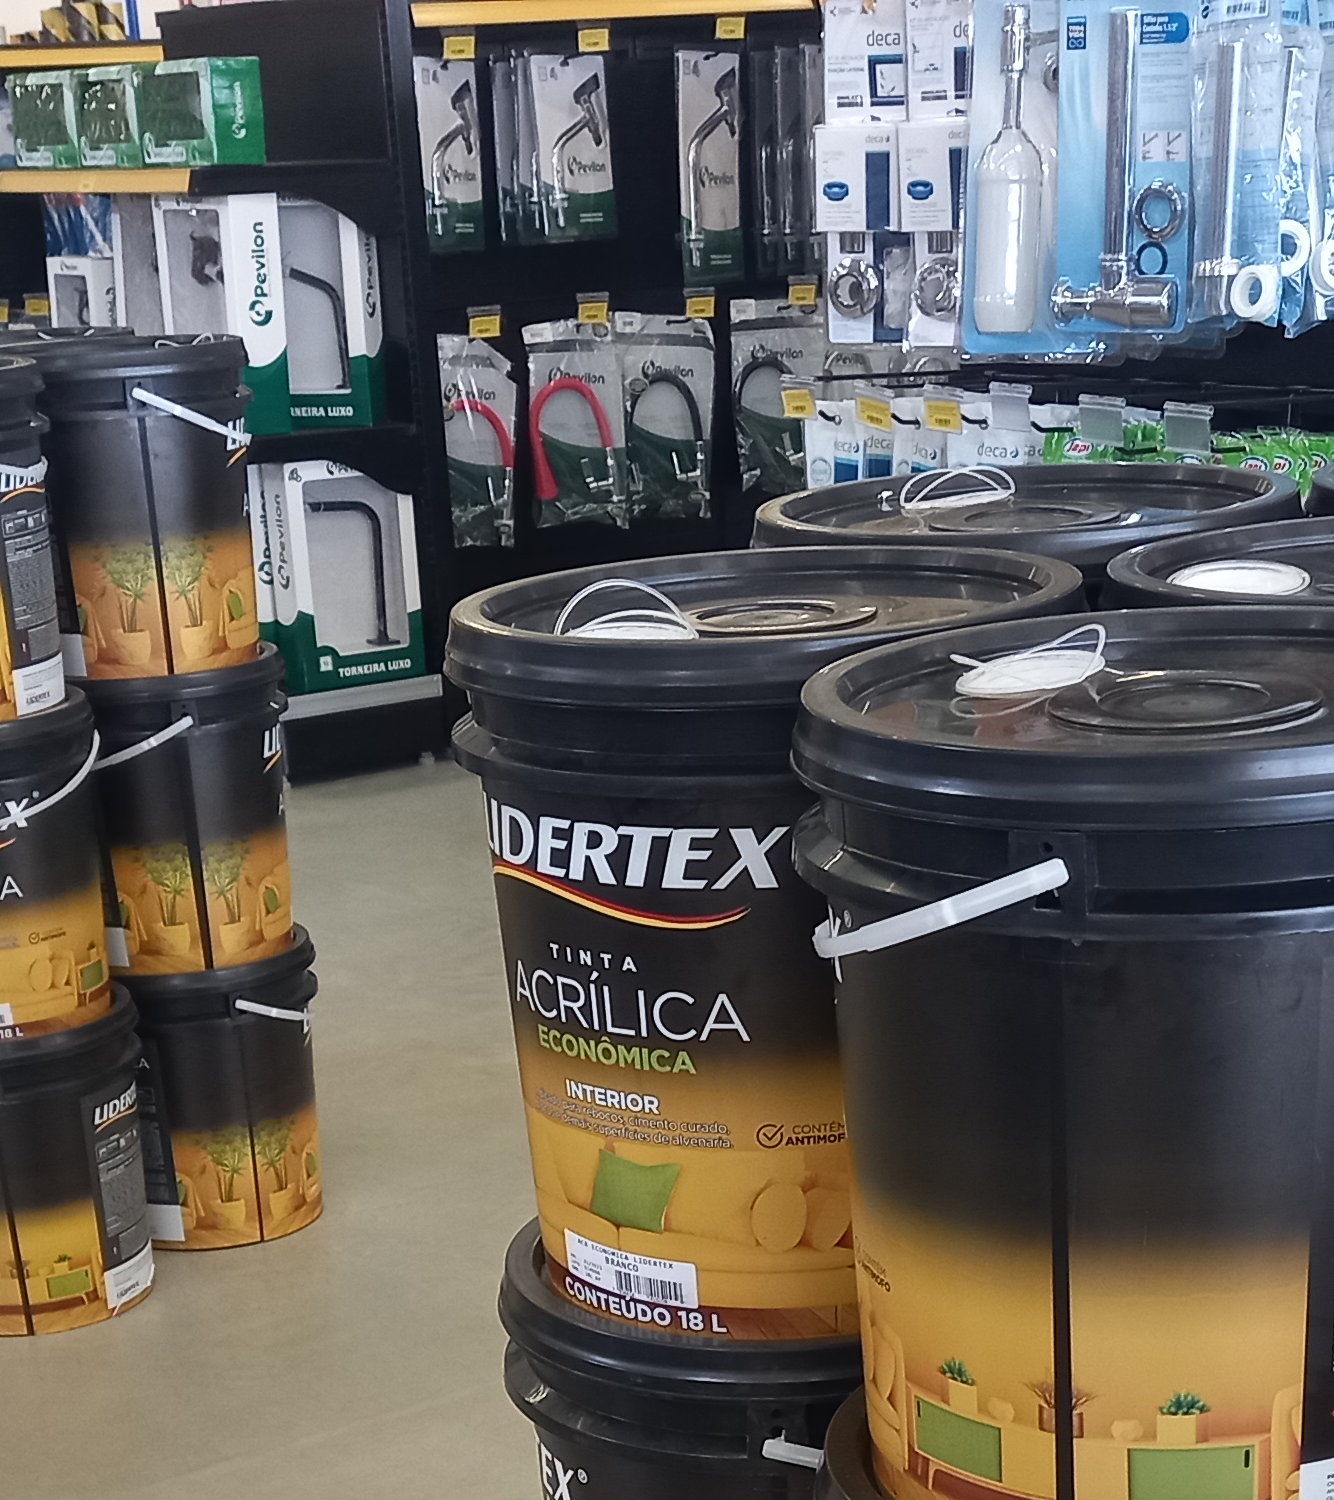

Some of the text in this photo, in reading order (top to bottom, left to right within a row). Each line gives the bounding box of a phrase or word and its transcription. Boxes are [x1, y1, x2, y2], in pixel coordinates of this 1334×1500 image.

[866, 30, 901, 47] deca
[252, 221, 269, 298] Pevilon
[327, 406, 353, 417] LUXO
[978, 443, 1007, 458] deca
[338, 658, 411, 678] TORNEIRA LUXO
[549, 942, 638, 973] TINTA
[515, 959, 751, 1042] ACRÍLICA
[14, 1027, 24, 1037] L
[537, 1023, 697, 1075] ECONÔMICA
[565, 1078, 660, 1115] INTERIOR
[583, 1107, 626, 1126] rebocos,
[629, 1116, 677, 1132] cimento
[680, 1123, 730, 1135] curado,
[593, 1123, 650, 1142] superfícies
[653, 1133, 669, 1144] de
[672, 1135, 734, 1149] alvenaria.
[605, 1256, 638, 1272] BRANCO
[633, 1256, 673, 1269] LIDERTEX
[565, 1276, 727, 1333] CONTEÚDO 18 L
